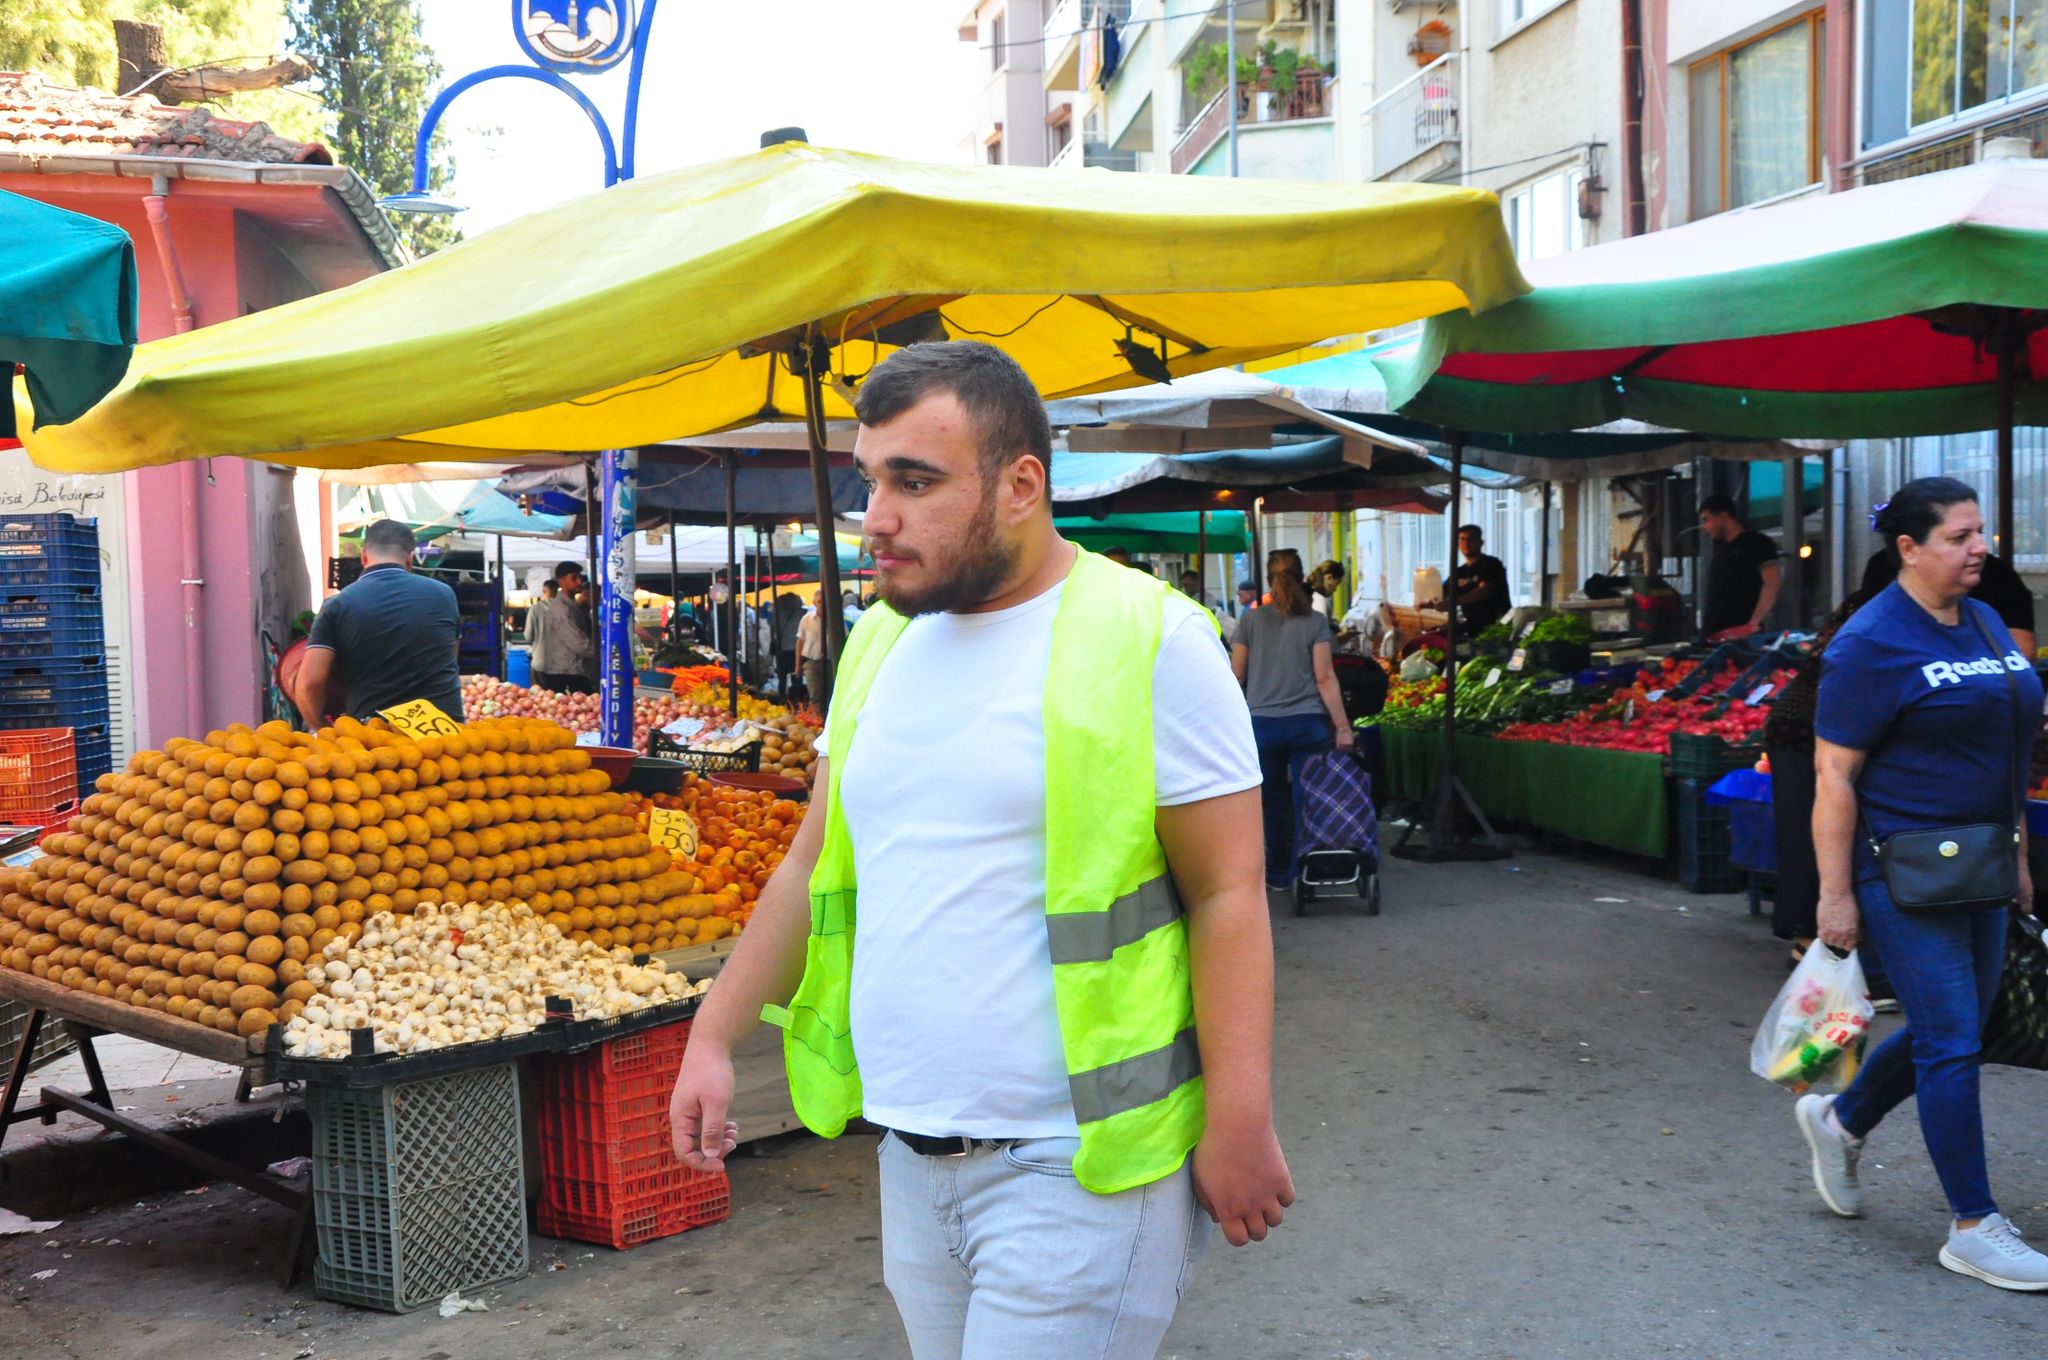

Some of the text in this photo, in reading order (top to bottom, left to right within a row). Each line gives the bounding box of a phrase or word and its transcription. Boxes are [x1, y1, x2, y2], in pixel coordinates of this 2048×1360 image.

[0, 491, 23, 505] isa
[654, 809, 672, 825] 3
[660, 827, 696, 856] 50
